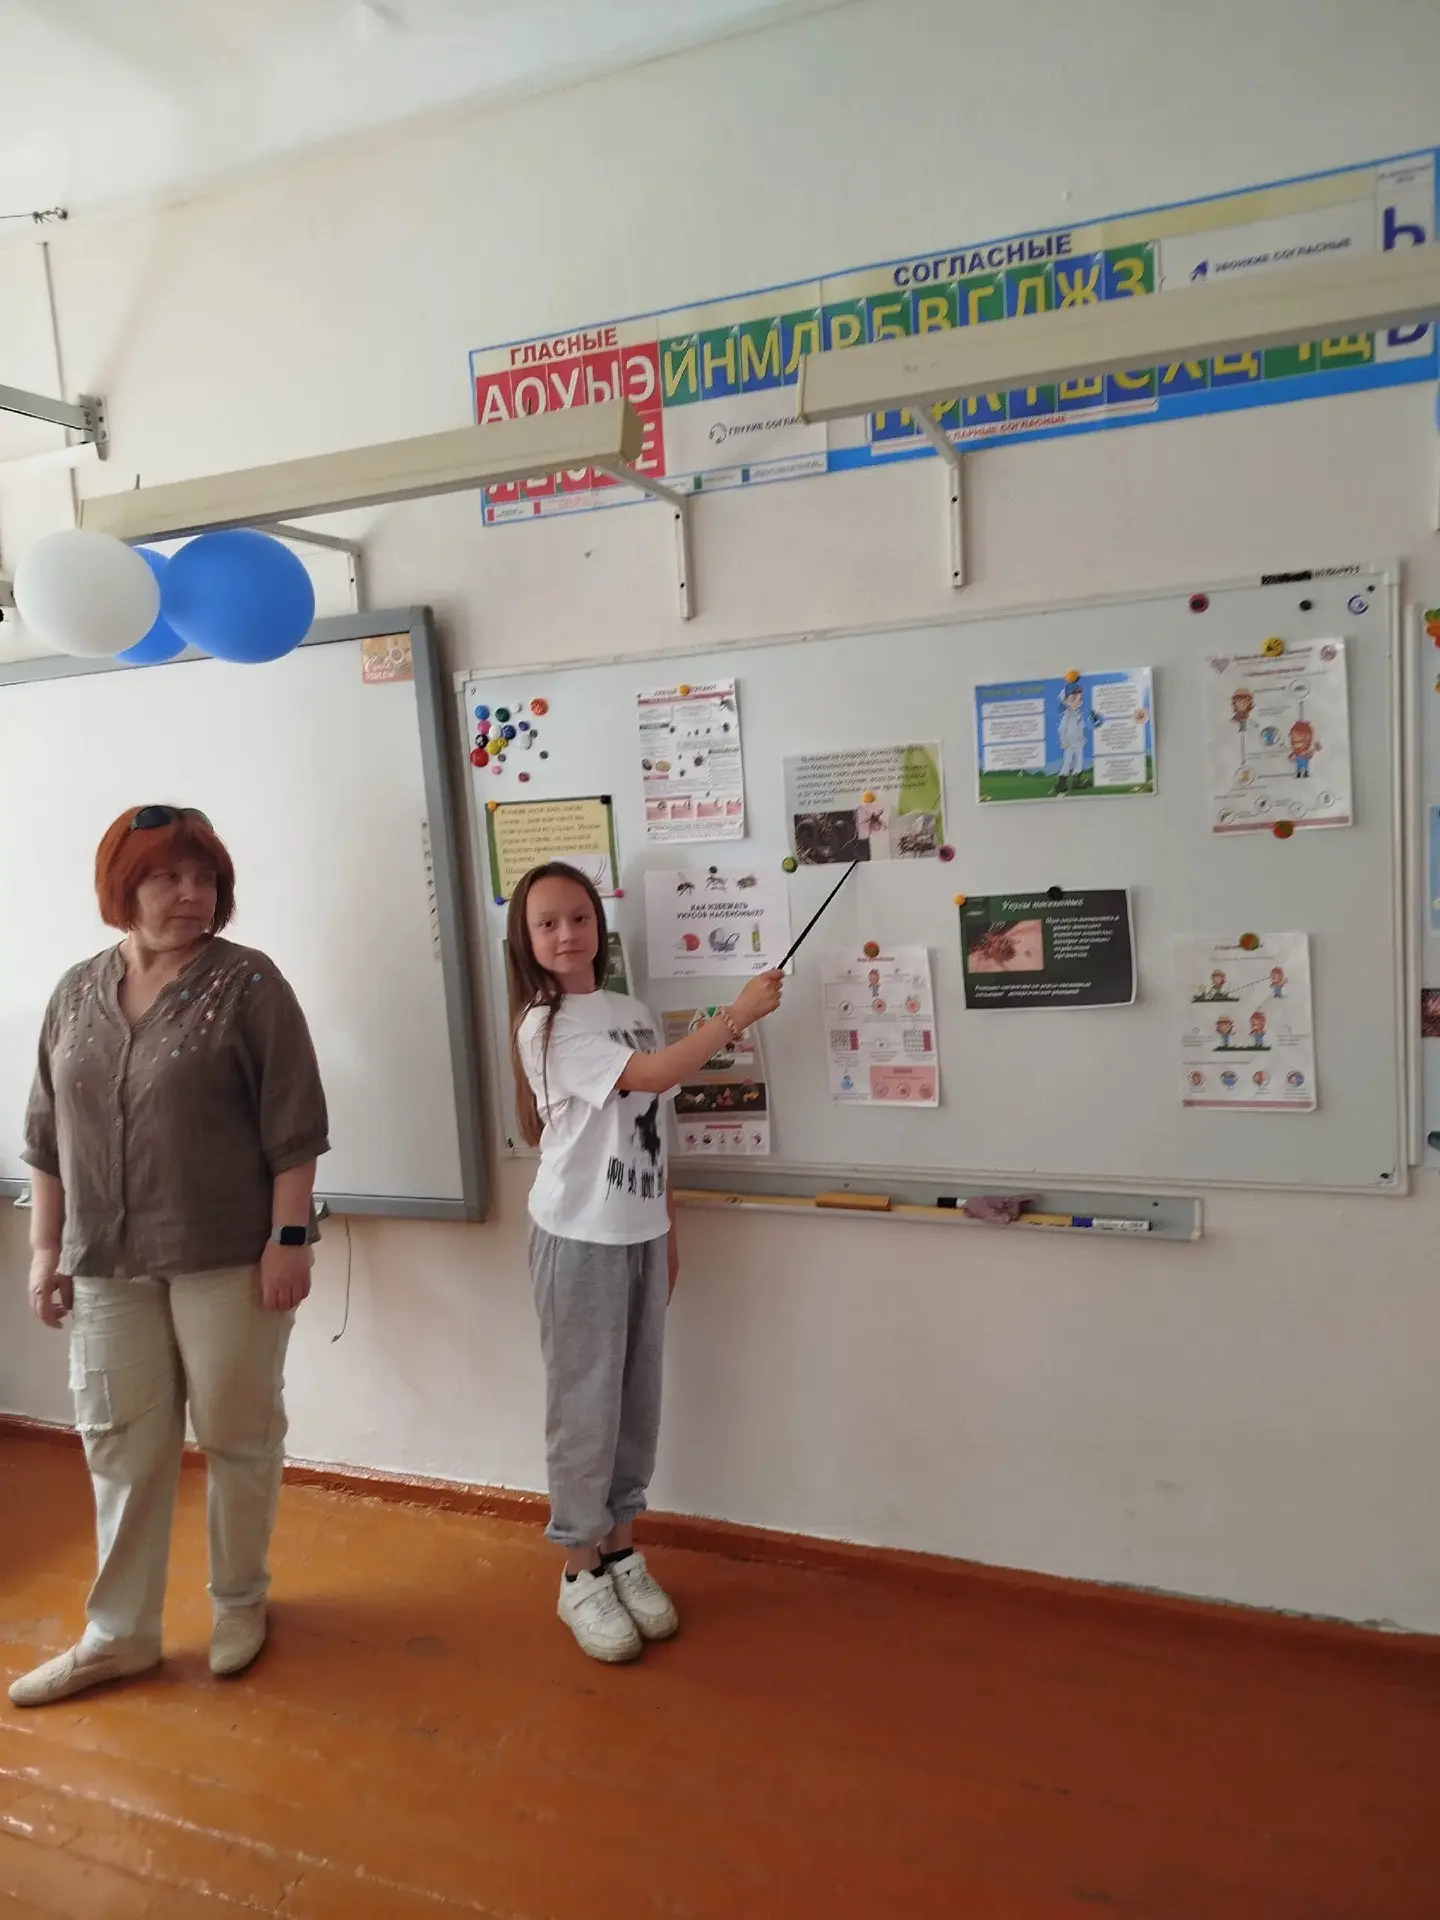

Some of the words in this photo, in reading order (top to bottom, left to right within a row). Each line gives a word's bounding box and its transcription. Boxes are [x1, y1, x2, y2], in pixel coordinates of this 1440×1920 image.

[894, 233, 1072, 286] СОГЛАСНЫЕ
[510, 327, 617, 366] ГЛАСНЫЕ
[1000, 415, 1067, 433] СОГЛАСНЫЕ
[676, 910, 708, 920] УКУСОВ
[709, 909, 763, 919] НАСЕКОМЫХ?
[690, 903, 706, 912] КАК
